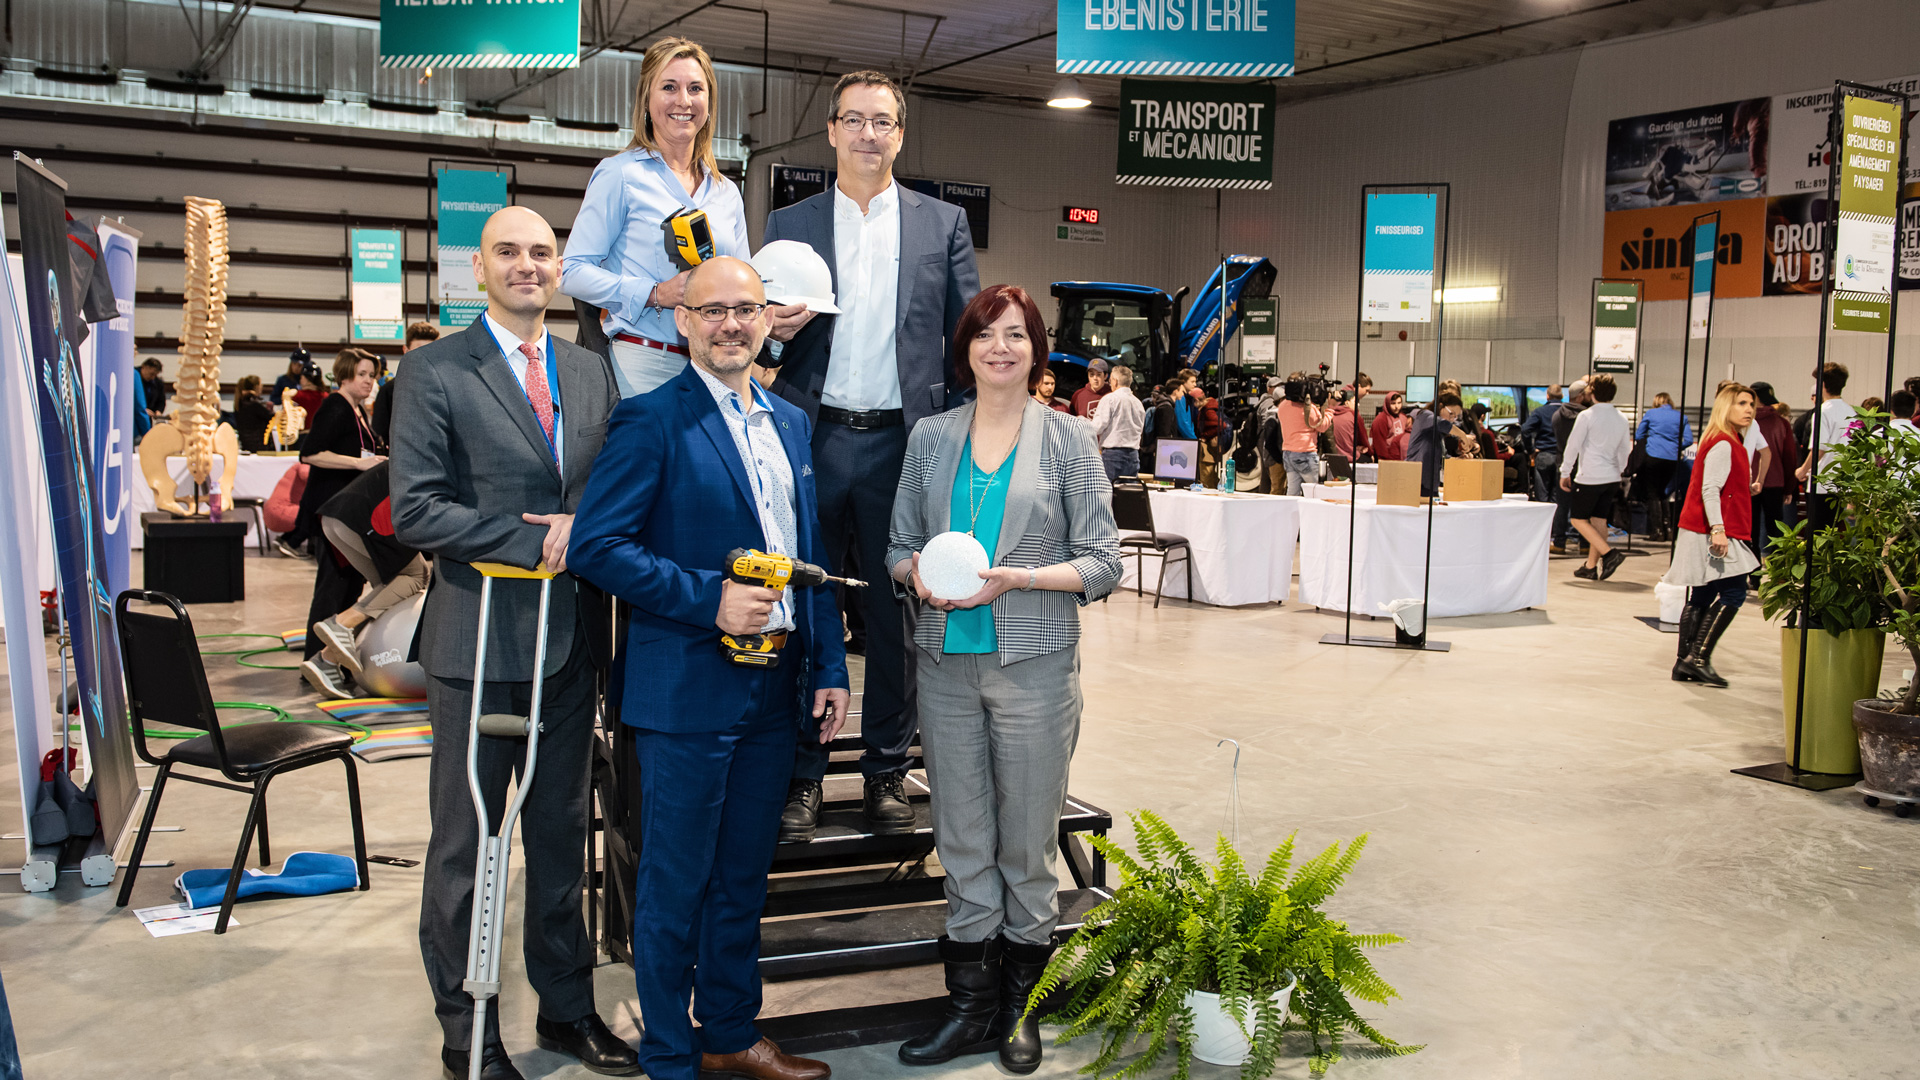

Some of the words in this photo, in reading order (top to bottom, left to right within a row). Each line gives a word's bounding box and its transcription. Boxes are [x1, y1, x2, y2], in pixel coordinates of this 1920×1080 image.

[1130, 99, 1265, 132] TRANSPORT
[1648, 120, 1685, 134] Gardien
[1686, 117, 1699, 129] du
[1128, 130, 1141, 142] ET
[1142, 129, 1262, 163] MÉCANIQUE
[1887, 140, 1896, 155] EN
[1848, 152, 1892, 173] AMÉNAGEMENT
[947, 185, 986, 197] PÉNALITÉ
[1853, 174, 1884, 192] PAYSAGER
[1375, 225, 1424, 235] FINISSEUR(SE)
[1771, 252, 1802, 284] AU
[1187, 346, 1200, 364] NEW
[1195, 317, 1219, 349] HOLLAND
